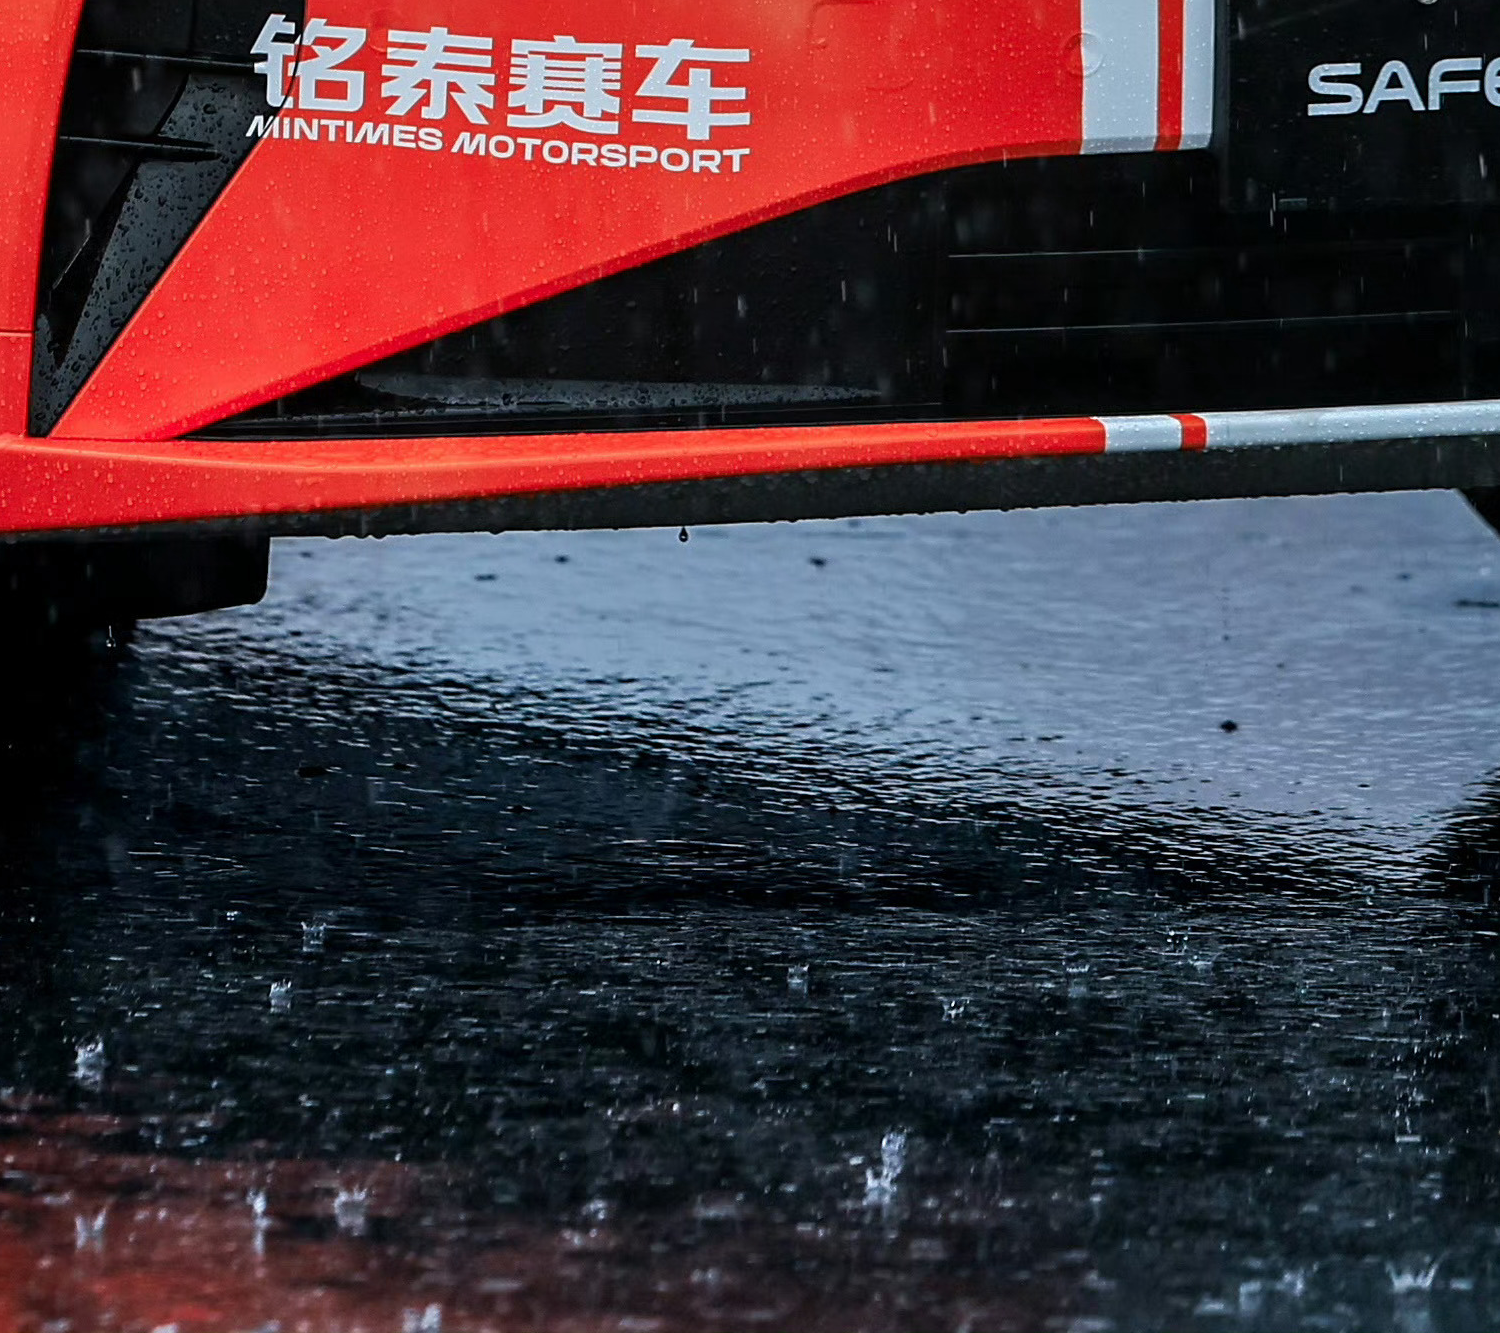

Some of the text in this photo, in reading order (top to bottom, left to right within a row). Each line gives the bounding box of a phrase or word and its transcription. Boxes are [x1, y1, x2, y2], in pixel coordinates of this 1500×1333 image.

[249, 14, 750, 140] 铭泰赛车
[246, 115, 751, 174] MINTIMES MOTORSPORT
